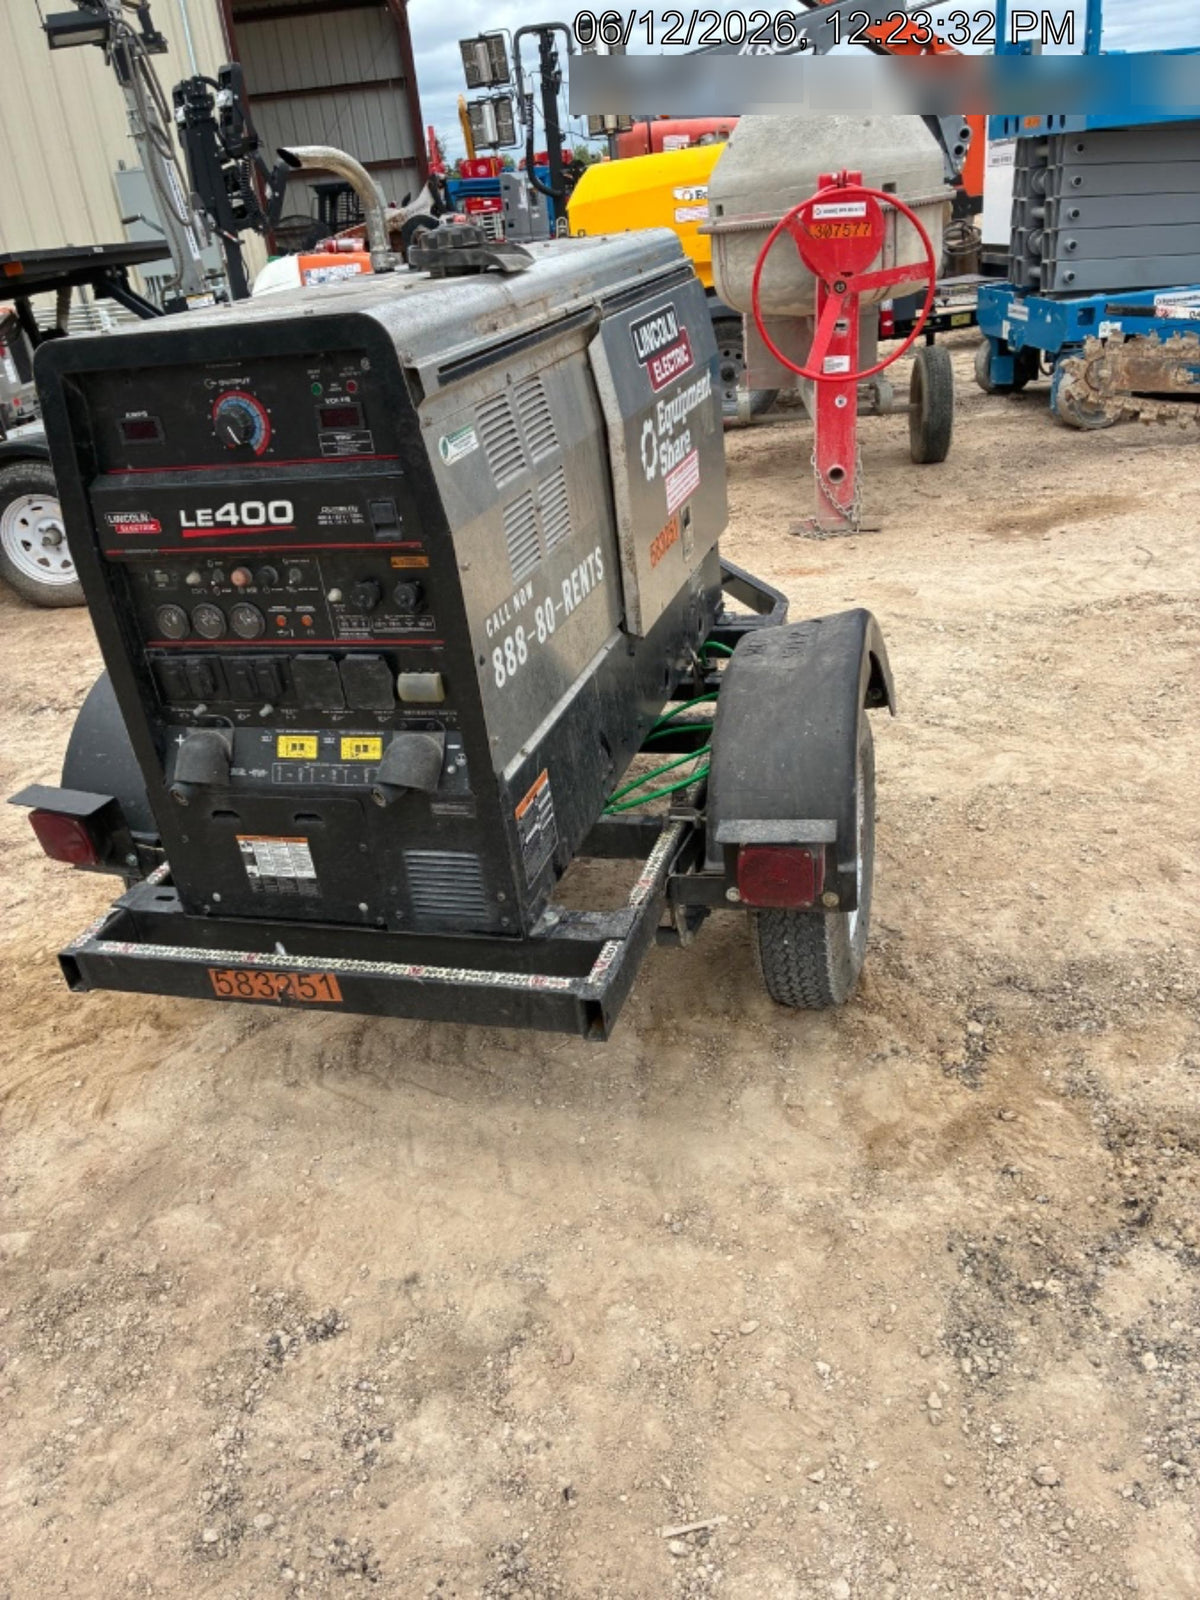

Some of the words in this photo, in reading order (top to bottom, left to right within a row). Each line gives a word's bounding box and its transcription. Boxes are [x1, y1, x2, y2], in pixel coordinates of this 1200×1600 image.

[814, 222, 871, 239] 307577
[633, 311, 679, 359] LINCOLN
[652, 344, 689, 383] ELECTRIC
[656, 368, 712, 436] Equipment
[660, 429, 692, 477] Share
[106, 513, 150, 524] LINCOLN
[179, 500, 295, 528] LE400
[485, 603, 512, 638] CALL
[513, 580, 534, 613] NOW
[492, 546, 604, 688] 888-80-RENTS
[214, 971, 335, 1000] 583251
